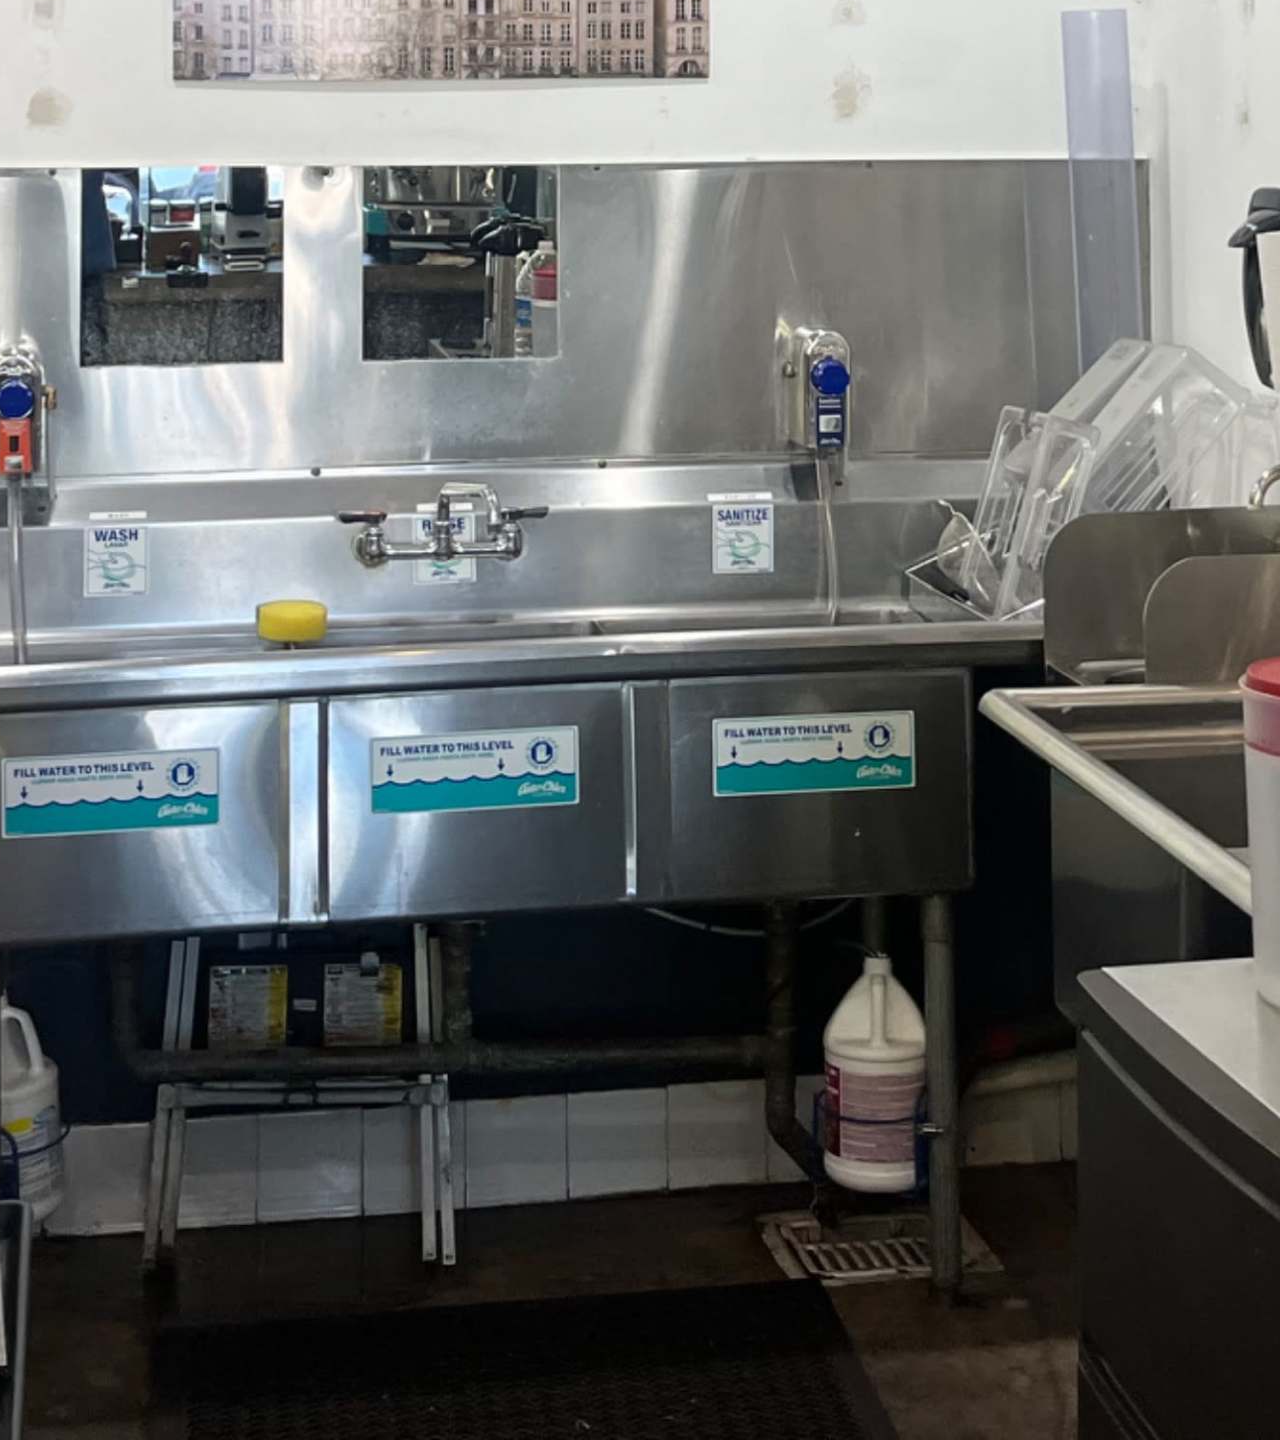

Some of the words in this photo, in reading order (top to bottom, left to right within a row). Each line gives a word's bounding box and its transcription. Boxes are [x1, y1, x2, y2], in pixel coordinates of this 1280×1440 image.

[717, 508, 769, 522] SANITIZE
[94, 528, 139, 542] WASH
[724, 728, 744, 738] FILL
[746, 725, 781, 737] WATER
[783, 725, 796, 736] TO
[797, 724, 820, 735] THIS
[821, 723, 853, 734] LEVEL
[380, 746, 401, 757] FILL
[403, 743, 440, 755] WATER
[442, 743, 455, 753] TO
[457, 741, 480, 752] THIS
[482, 740, 514, 751] LEVEL
[14, 767, 38, 778] FILL
[39, 764, 77, 777] WATER
[78, 764, 93, 775] TO
[94, 762, 119, 773] THIS
[120, 761, 155, 772] LEVEL
